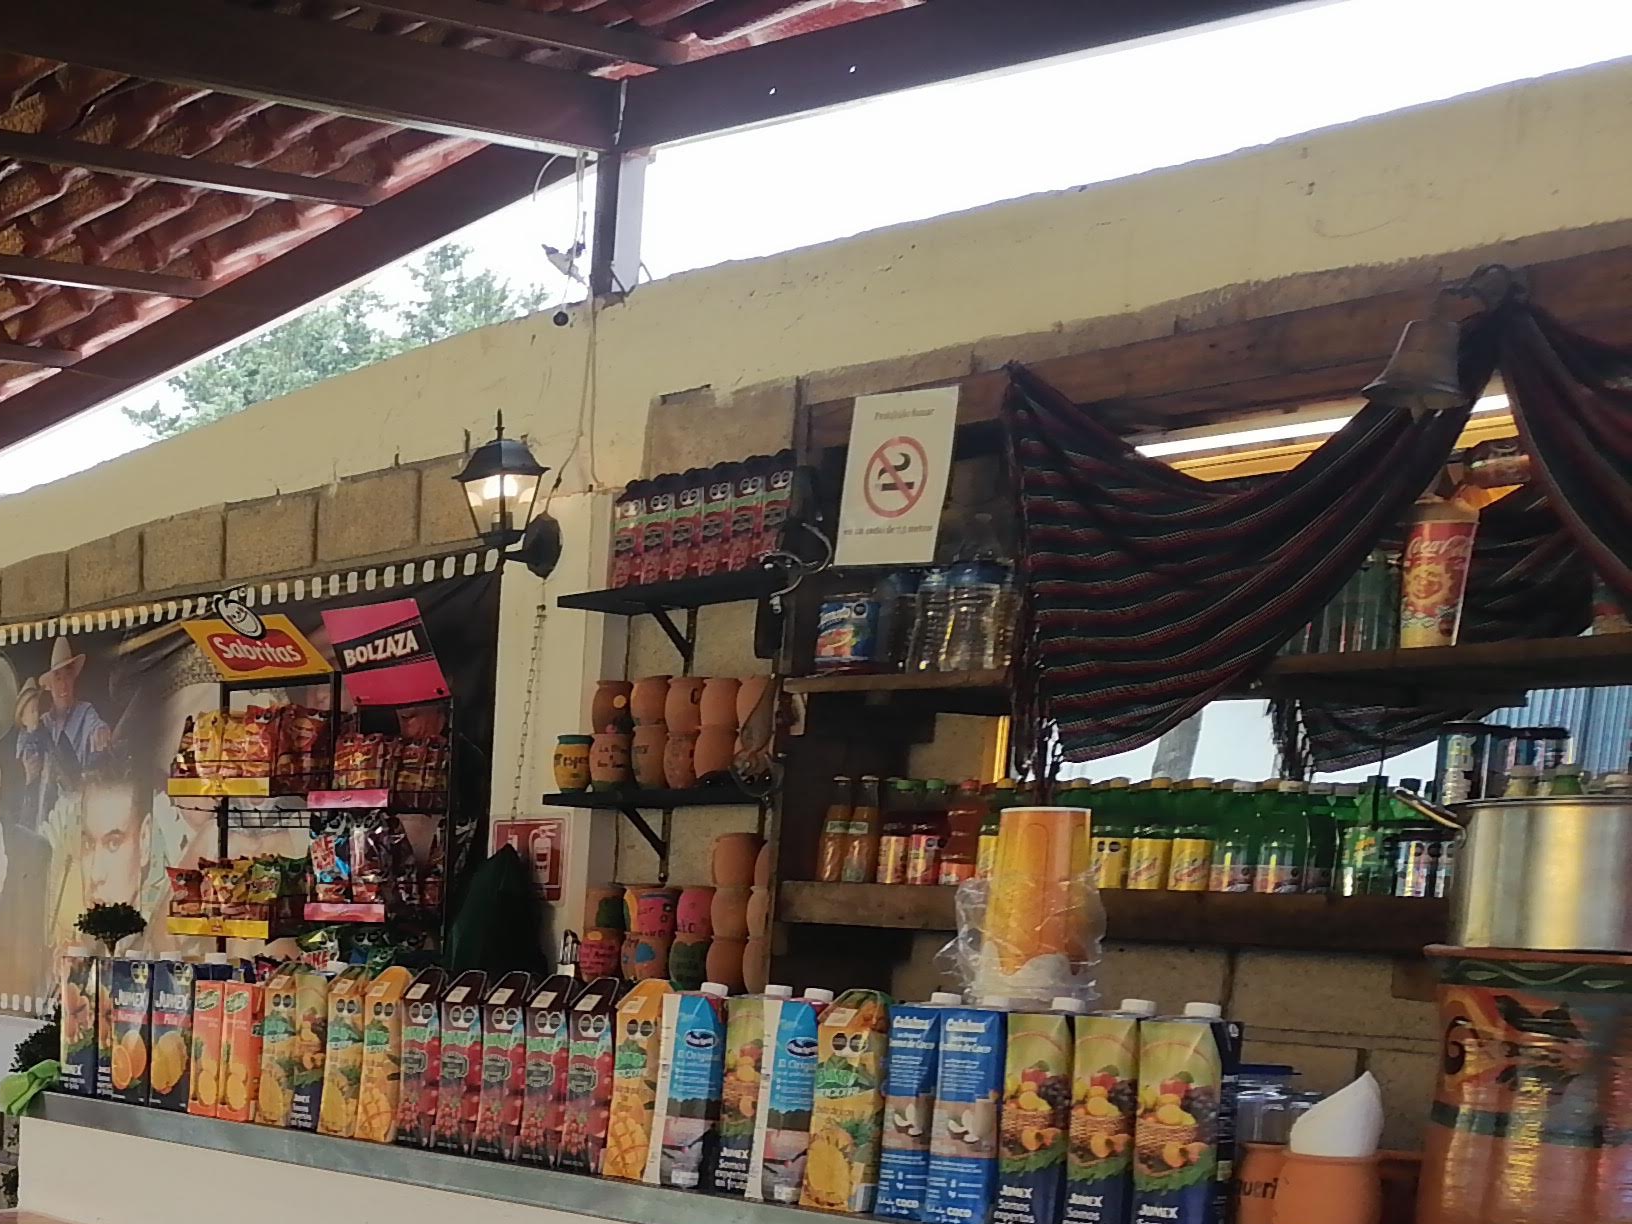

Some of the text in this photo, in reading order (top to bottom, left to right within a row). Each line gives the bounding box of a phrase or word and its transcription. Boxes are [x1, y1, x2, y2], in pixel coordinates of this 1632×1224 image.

[212, 637, 302, 663] Sabritas
[343, 630, 418, 668] BOLZAZA
[1000, 1185, 1033, 1199] JUMEX
[998, 1198, 1030, 1212] Somos
[1069, 1193, 1104, 1208] JUMEX
[1067, 1207, 1100, 1221] Somos
[1138, 1204, 1179, 1219] JUMEX
